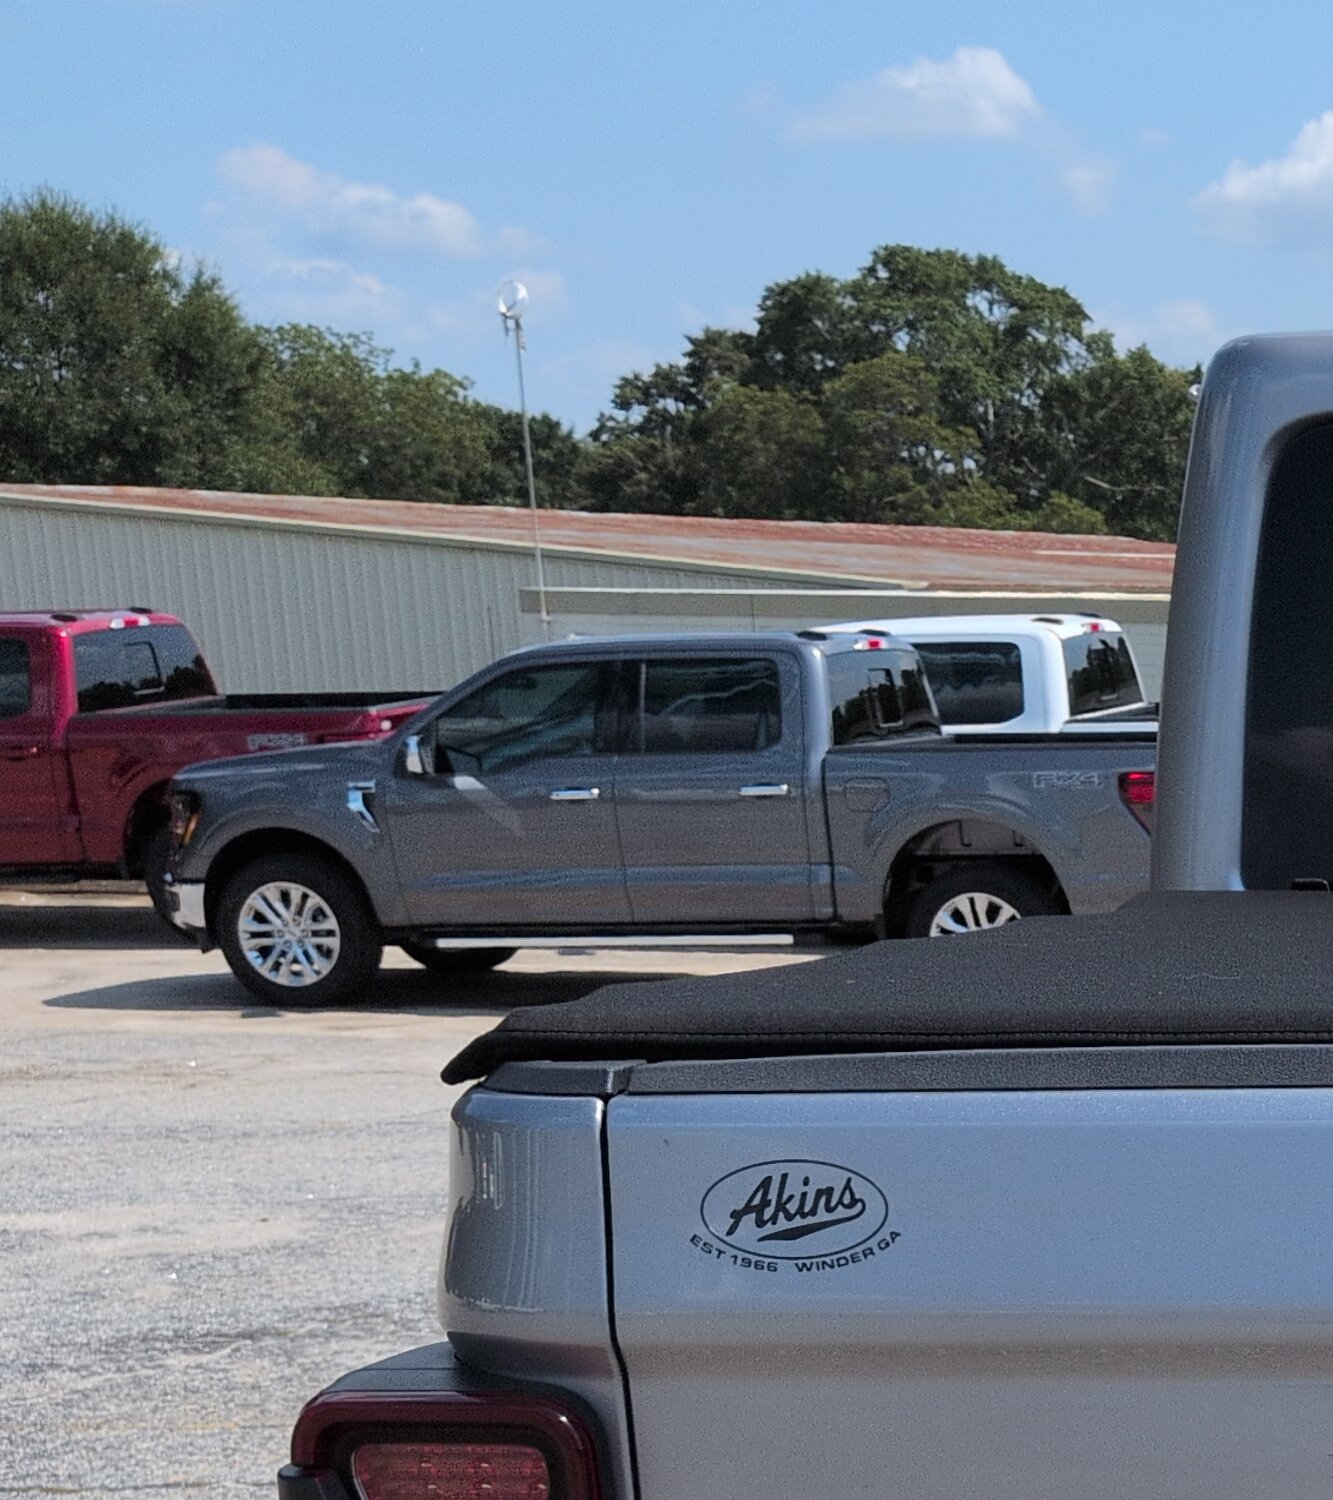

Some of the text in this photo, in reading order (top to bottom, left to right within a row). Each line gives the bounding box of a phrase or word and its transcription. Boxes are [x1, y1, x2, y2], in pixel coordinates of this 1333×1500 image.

[726, 1173, 866, 1242] Akins
[690, 1230, 902, 1273] EST 1966 WINDER GA
